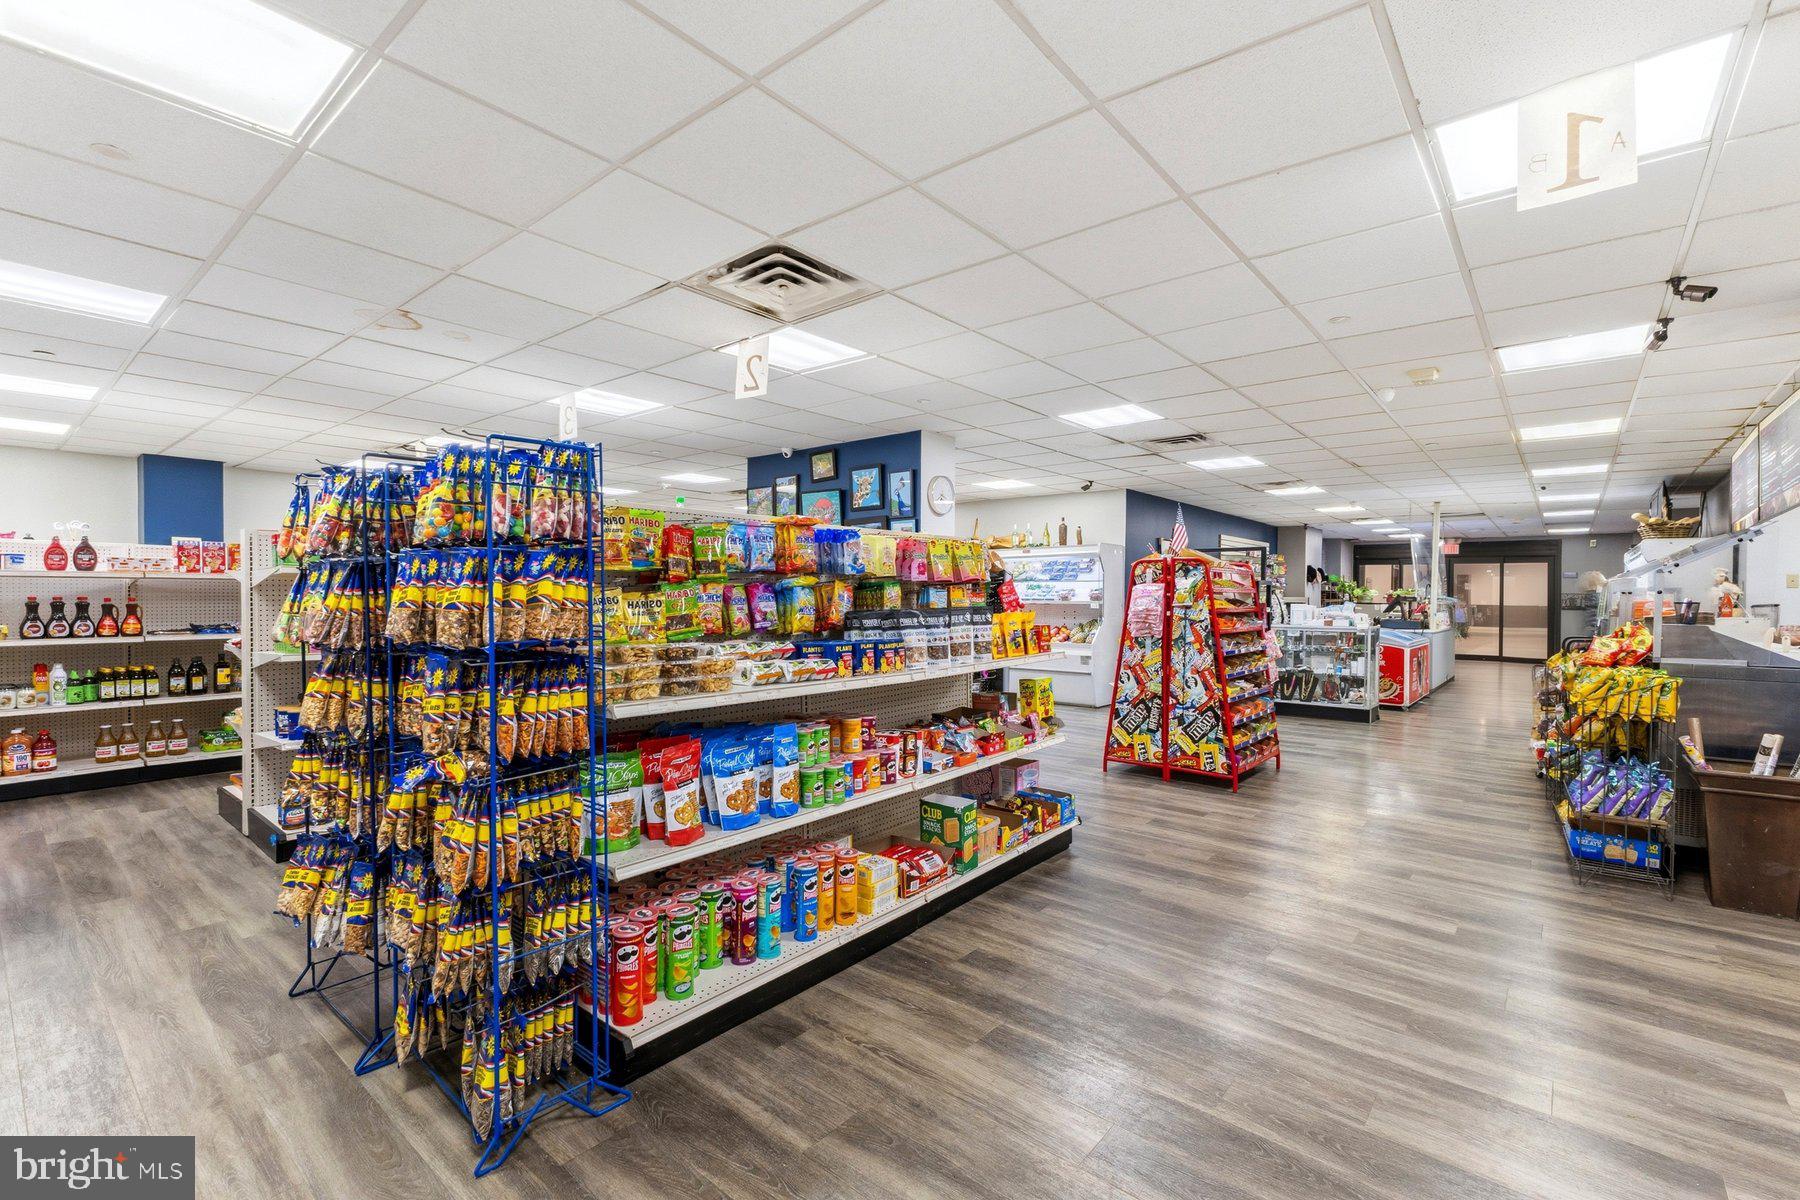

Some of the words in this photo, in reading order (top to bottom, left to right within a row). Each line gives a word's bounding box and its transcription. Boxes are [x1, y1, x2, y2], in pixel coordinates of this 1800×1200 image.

[604, 516, 626, 526] RIBO
[629, 516, 660, 528] HARIBO
[665, 588, 694, 600] HARIBO
[627, 599, 663, 610] HARIBO
[921, 804, 943, 820] CLUB
[964, 809, 977, 823] CLUB
[923, 820, 942, 829] SNACK
[923, 825, 942, 834] STACKS
[616, 960, 639, 973] PRINGLES
